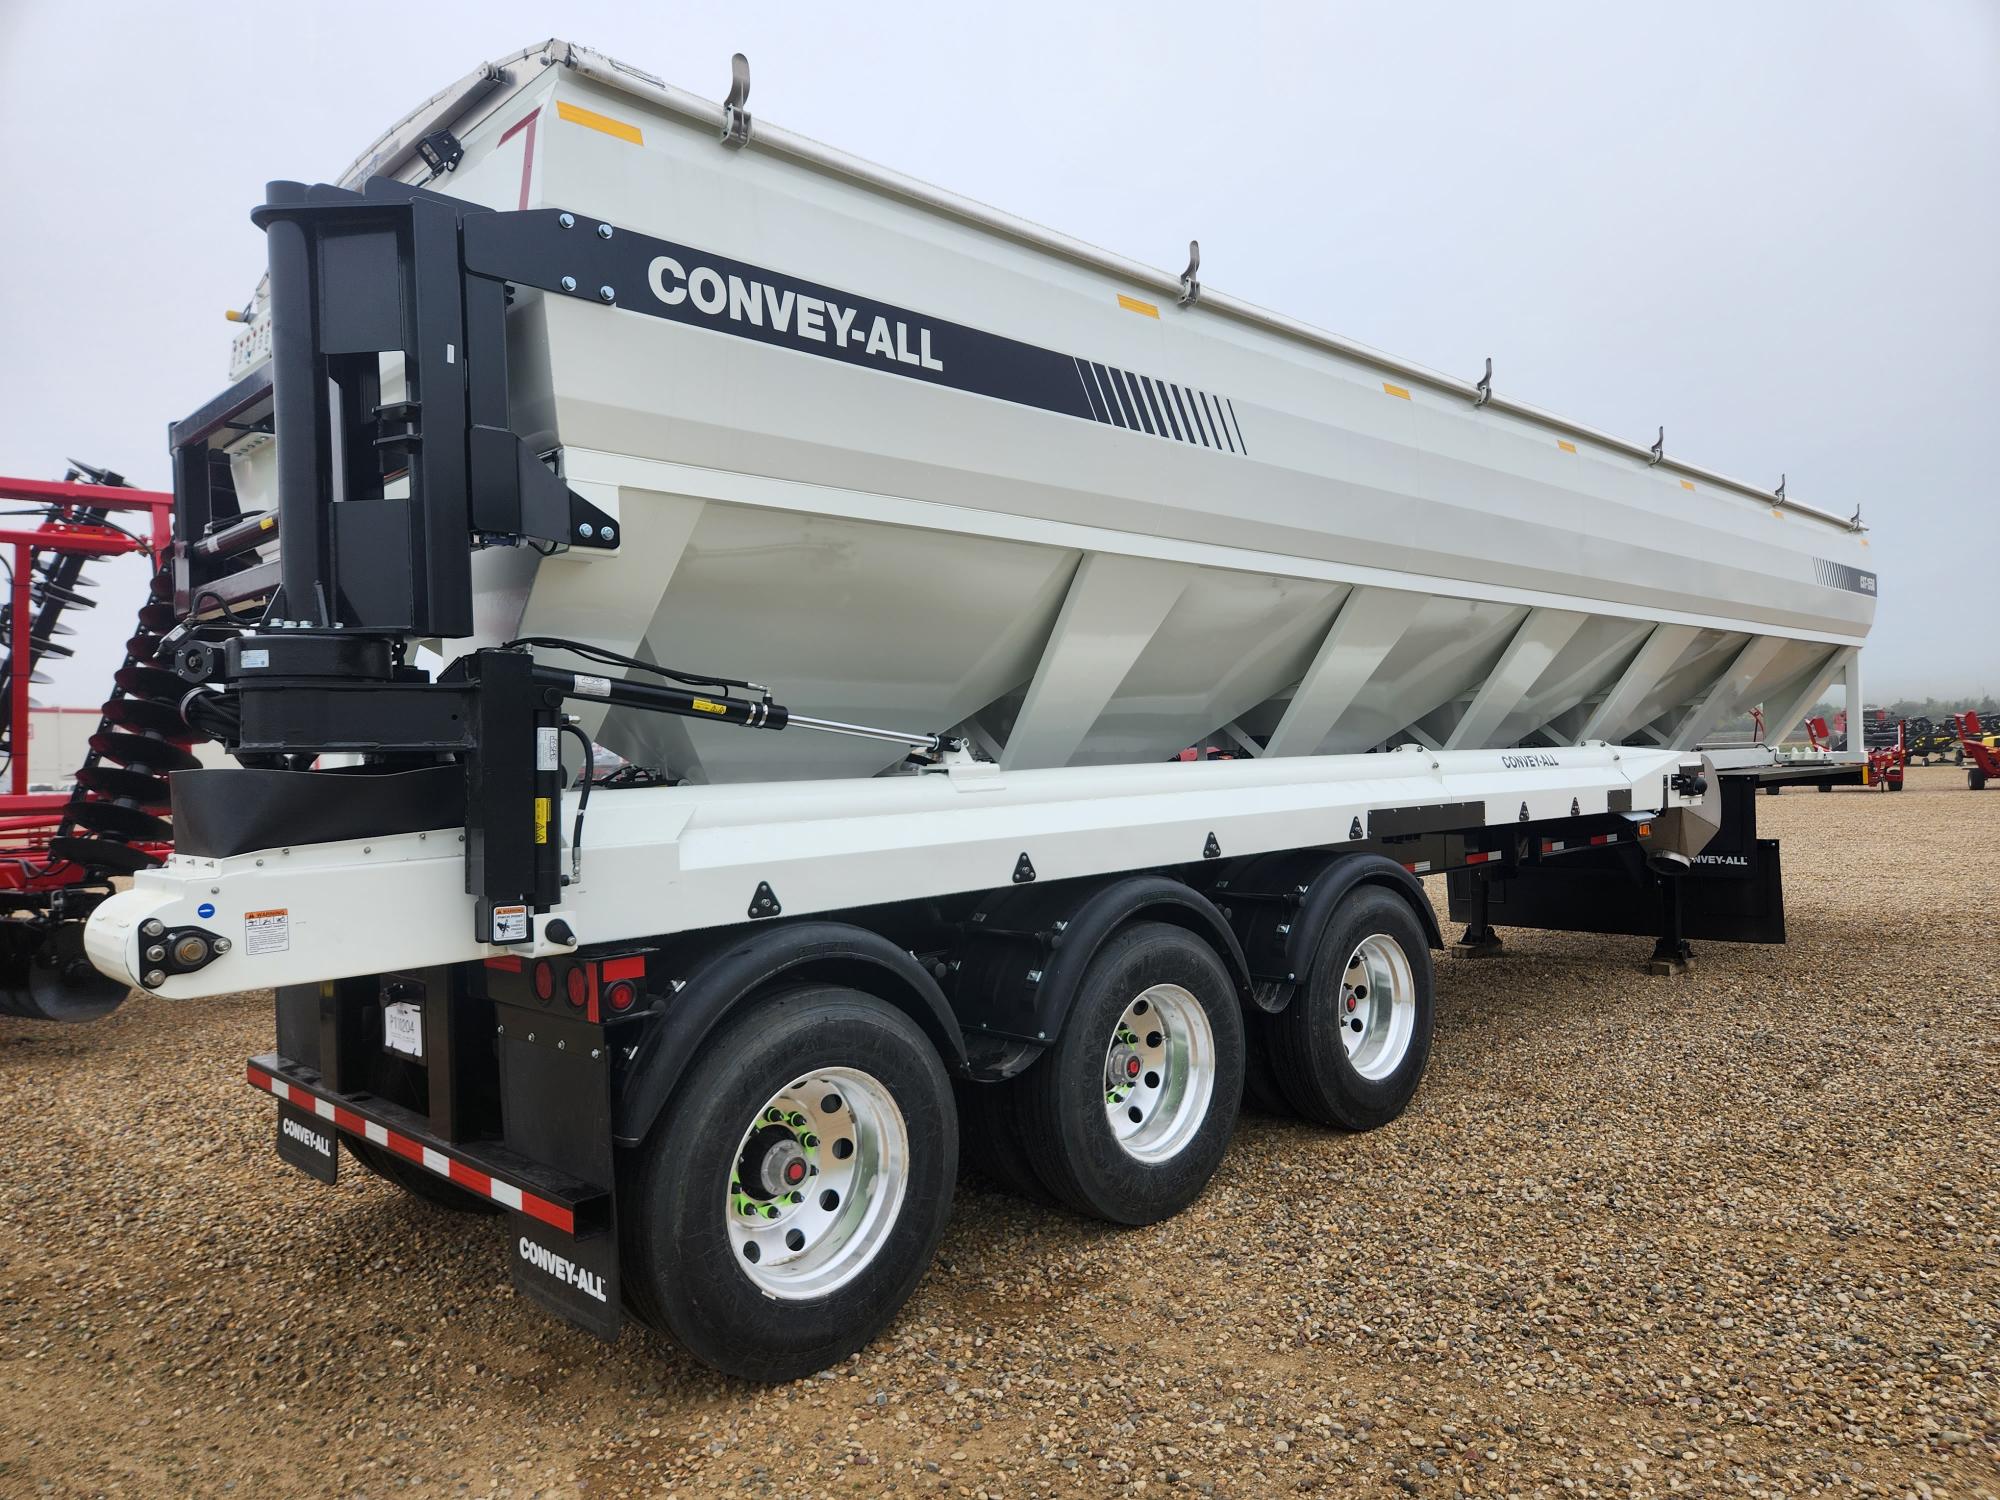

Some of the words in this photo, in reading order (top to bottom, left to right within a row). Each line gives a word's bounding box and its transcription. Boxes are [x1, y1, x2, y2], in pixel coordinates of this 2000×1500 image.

[648, 256, 943, 372] CONVEY-ALL
[1501, 755, 1559, 769] CONVEY-ALL
[1692, 855, 1748, 866] NVEY-ALL
[283, 1117, 331, 1157] CONVEY-ALL
[519, 1236, 607, 1303] CONVEY-ALL
